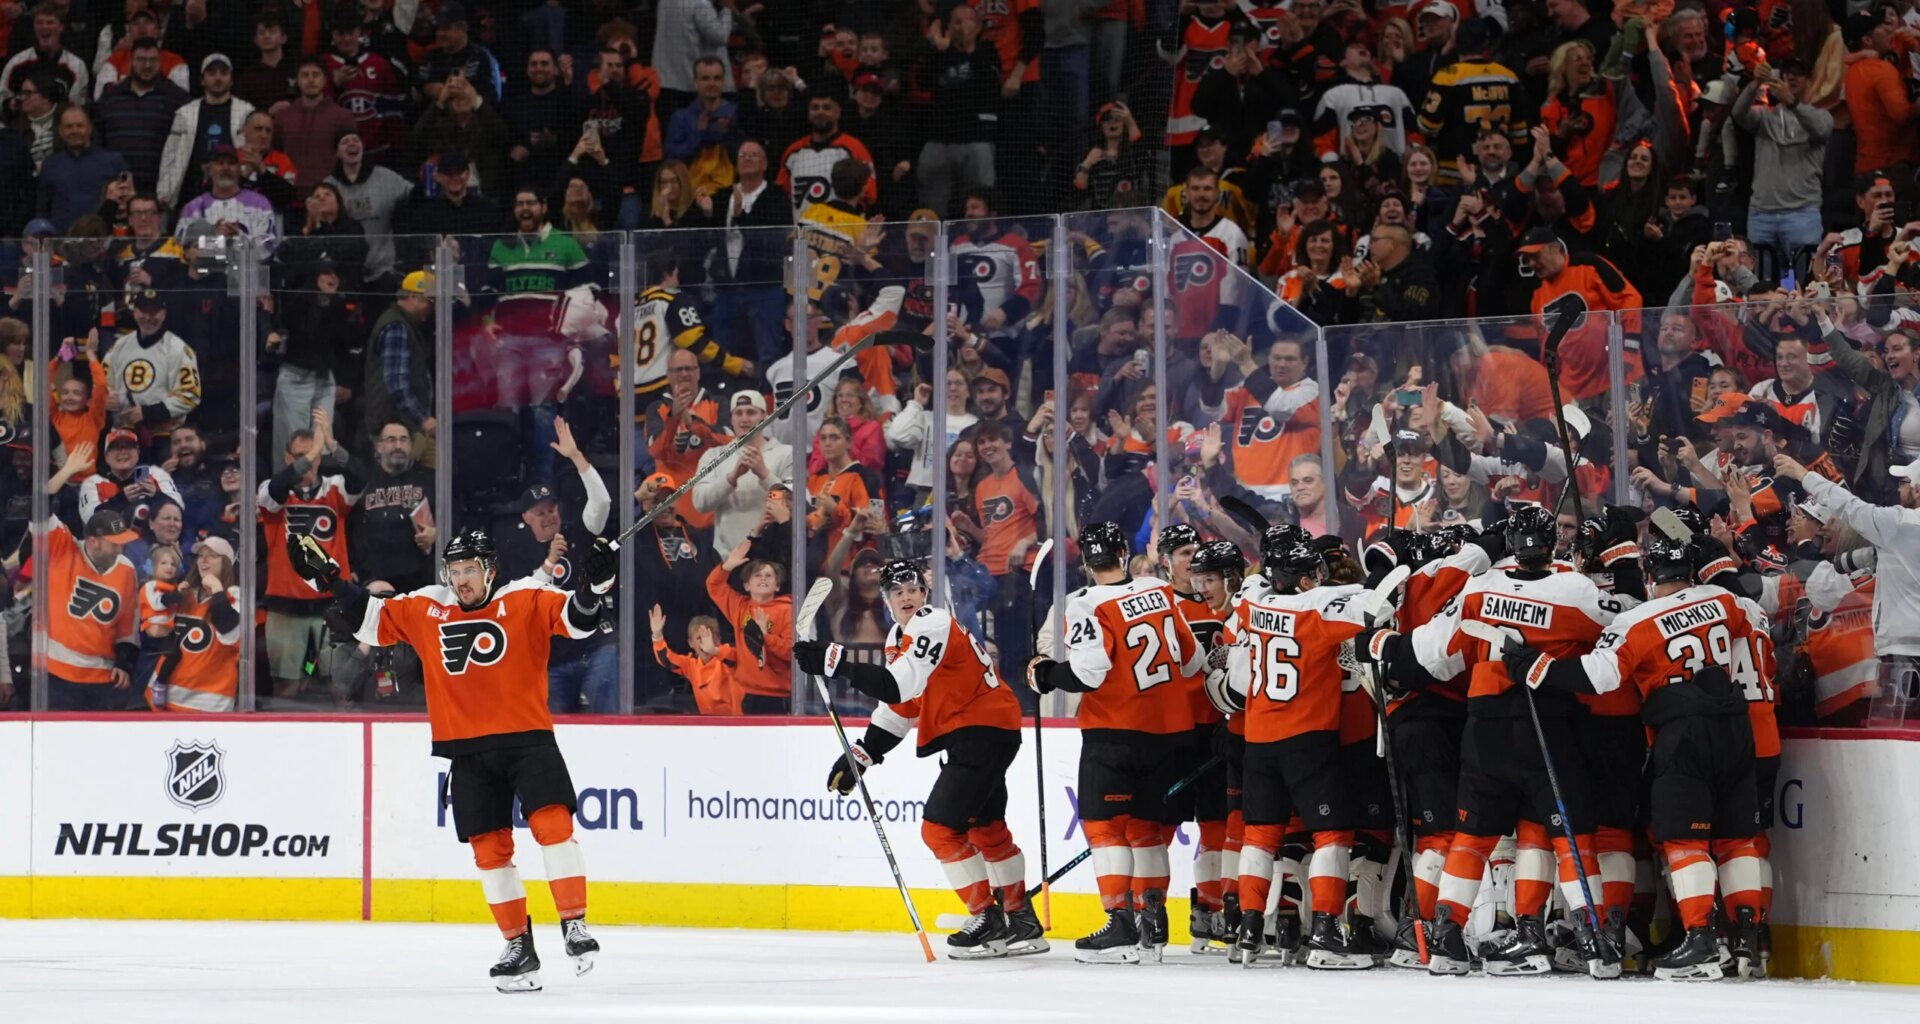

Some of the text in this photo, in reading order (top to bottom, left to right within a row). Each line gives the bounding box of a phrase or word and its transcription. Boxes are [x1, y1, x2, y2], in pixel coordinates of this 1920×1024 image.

[131, 366, 147, 386] B
[365, 485, 423, 510] FLYERS
[1090, 543, 1103, 554] 24
[1526, 536, 1534, 547] 6
[1669, 549, 1682, 560] 39
[496, 600, 507, 618] A
[1122, 592, 1167, 618] SEELER
[1484, 596, 1548, 626] SANHEIM
[1070, 618, 1097, 645] 24
[1660, 602, 1722, 635] MICHKOV
[914, 635, 943, 666] 94
[1667, 623, 1733, 684] 39
[177, 758, 215, 797] NHL
[689, 789, 926, 823] holmanauto.com
